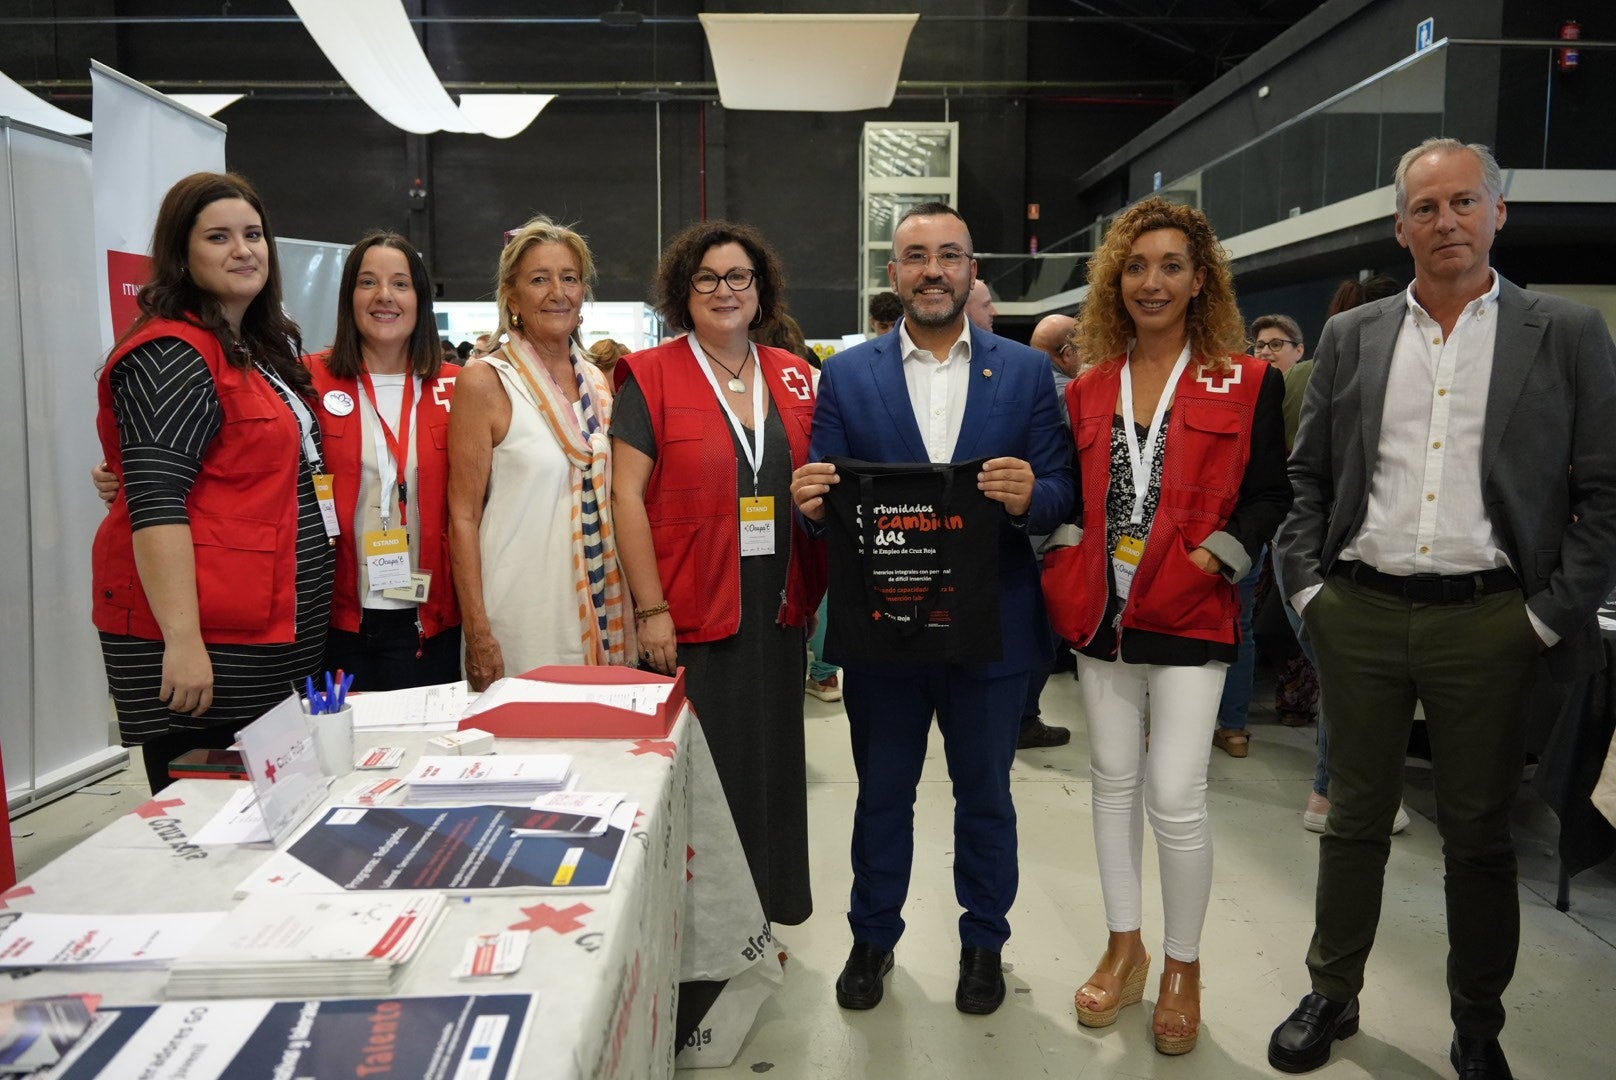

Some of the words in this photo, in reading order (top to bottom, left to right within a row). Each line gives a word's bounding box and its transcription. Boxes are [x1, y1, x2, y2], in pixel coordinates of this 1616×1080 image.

[372, 538, 400, 548] ESTAND
[148, 818, 187, 842] Cruz
[355, 1001, 402, 1078] Talento
